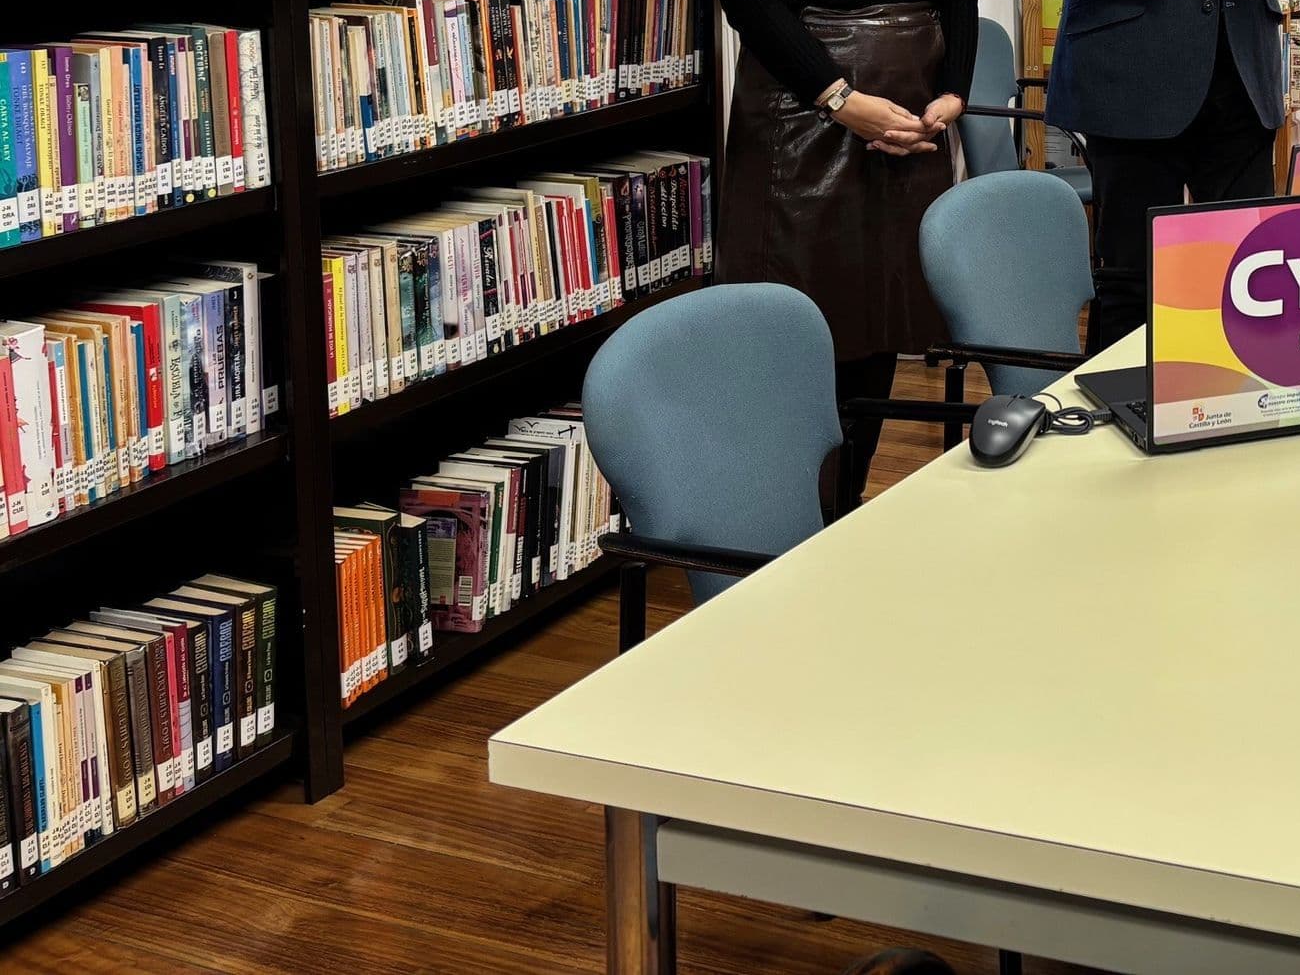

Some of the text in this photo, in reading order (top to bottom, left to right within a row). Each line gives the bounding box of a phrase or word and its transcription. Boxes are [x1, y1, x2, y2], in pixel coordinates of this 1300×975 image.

[0, 99, 11, 162] CARTA AL REY
[22, 103, 30, 136] BOSQUE
[160, 128, 168, 155] CAÍDOS
[2, 212, 15, 220] DRA
[483, 247, 493, 286] Rivales
[216, 324, 224, 389] PRUEBAS
[233, 351, 241, 382] MORTAL
[170, 358, 182, 399] ESCUELA
[1189, 420, 1211, 429] Castilla
[1216, 417, 1232, 425] León
[12, 506, 25, 514] CUE
[242, 607, 255, 650] GREGOR
[262, 598, 276, 639] GREGOR
[194, 631, 208, 674] GREGOR
[219, 618, 232, 662] GREGOR
[156, 671, 169, 718] ARTEMIS
